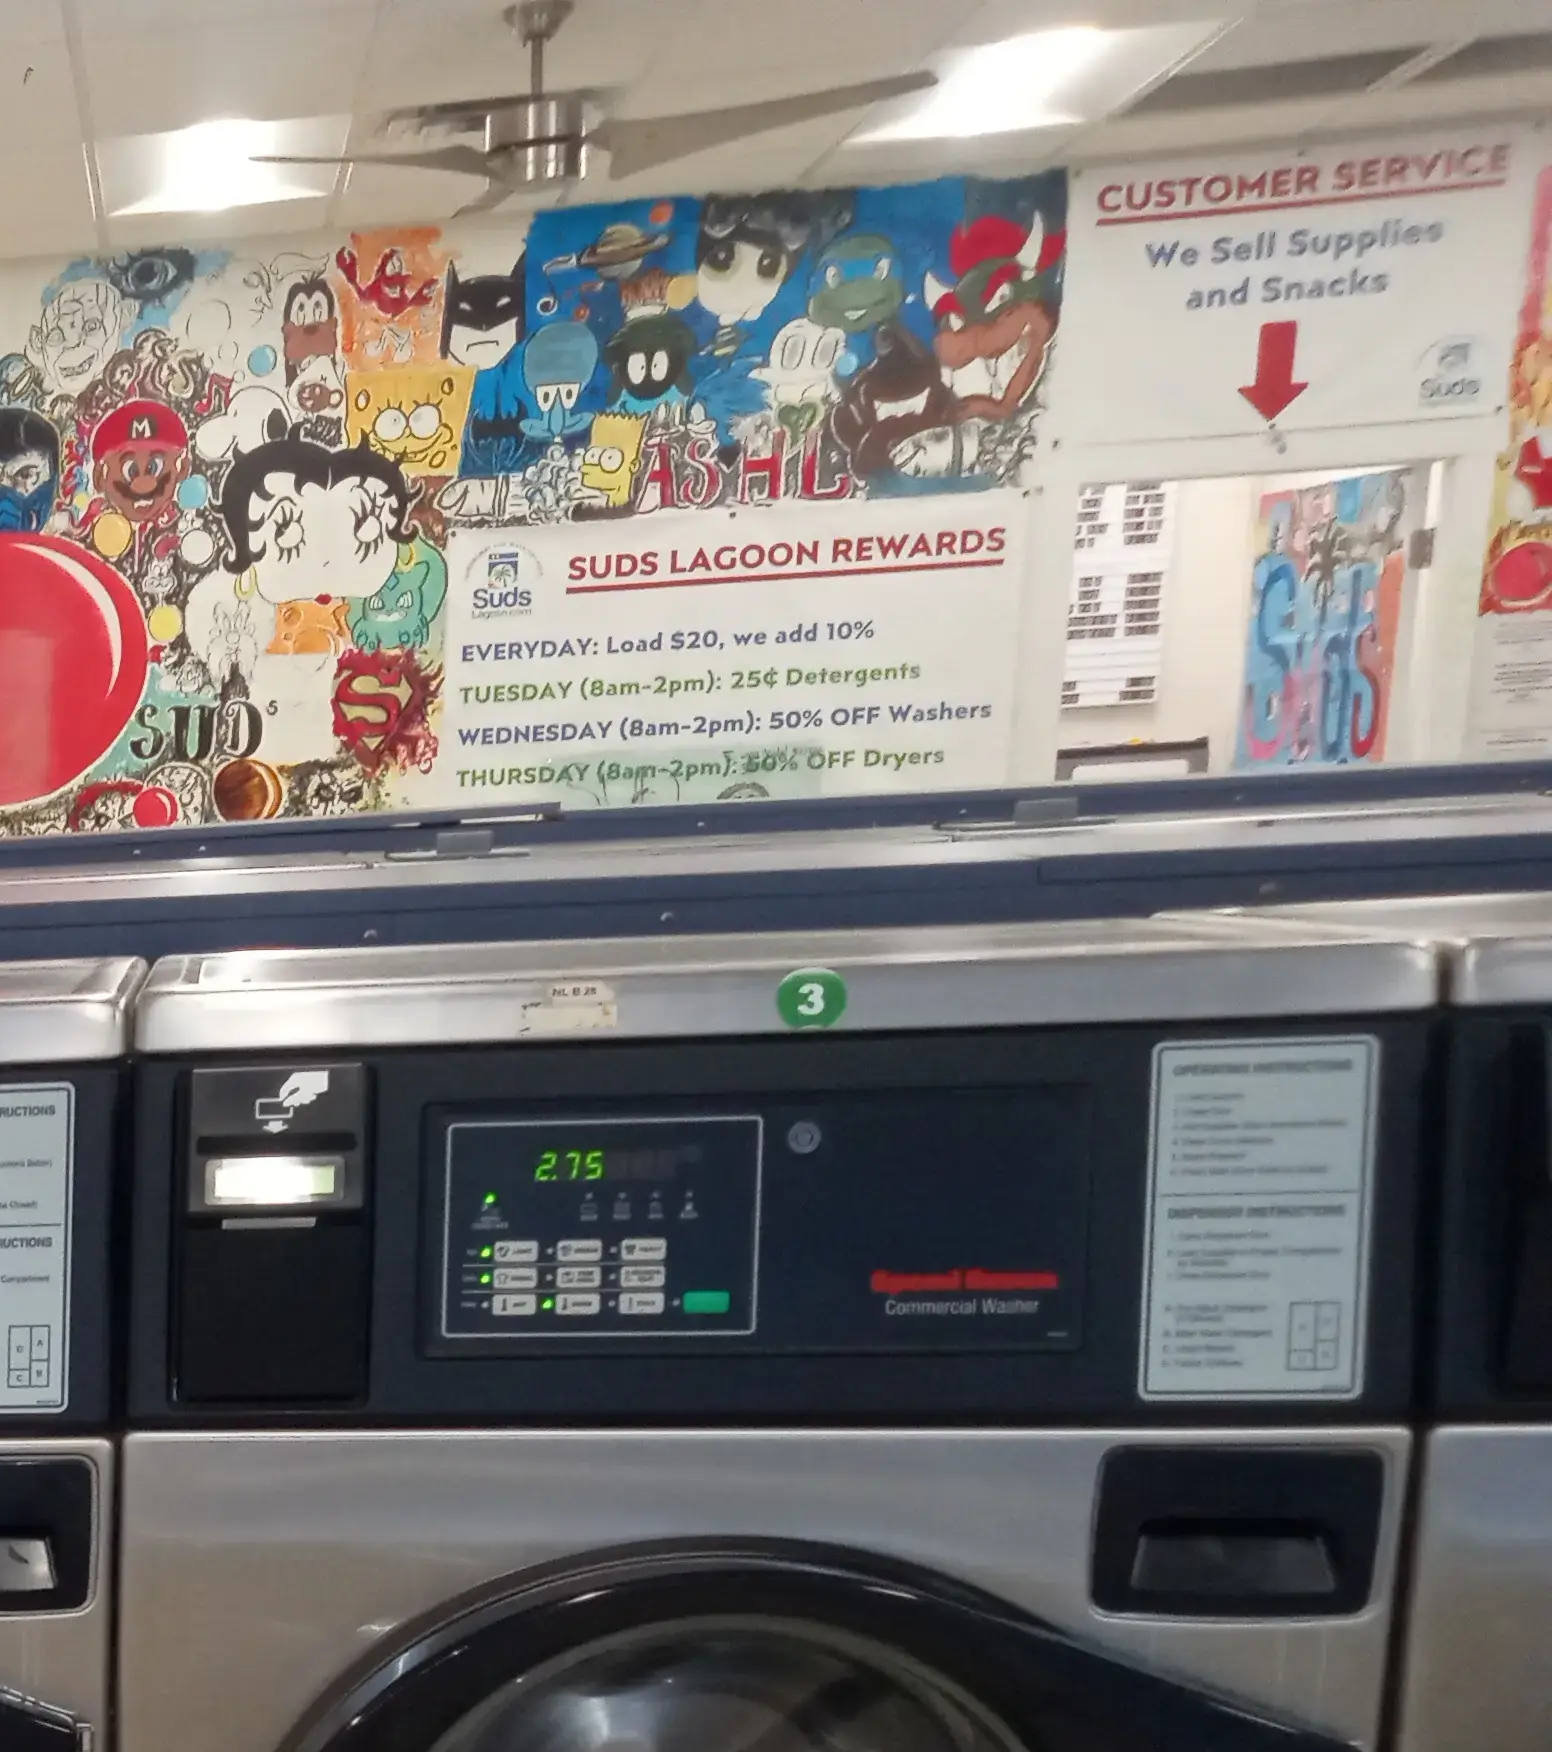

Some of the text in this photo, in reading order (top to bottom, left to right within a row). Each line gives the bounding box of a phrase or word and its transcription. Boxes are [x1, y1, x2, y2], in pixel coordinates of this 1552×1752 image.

[1097, 142, 1512, 214] CUSTOMER SERVICE
[1145, 217, 1444, 270] We Sell Supplies
[1186, 268, 1390, 312] and Snacks
[568, 550, 659, 581] SUDS
[670, 539, 819, 575] LAGOON
[832, 527, 1007, 565] REWARDS
[473, 587, 533, 609] Suds
[462, 618, 876, 663] EVERYDAY: Load $20, we add 10%
[459, 661, 921, 705] TUESDAY (8am-2pm): 25¢ Detergents
[458, 700, 992, 747] WEDNESDAY (8am-2pm): 50% OFF Washers
[456, 763, 590, 790] THURSDAY
[596, 751, 739, 785] (8am-2pm):
[806, 747, 856, 771] OFF
[862, 746, 946, 772] Dryers
[797, 983, 825, 1016] 3
[534, 1151, 604, 1182] 2.75
[885, 1298, 1040, 1315] Commercial Washer
